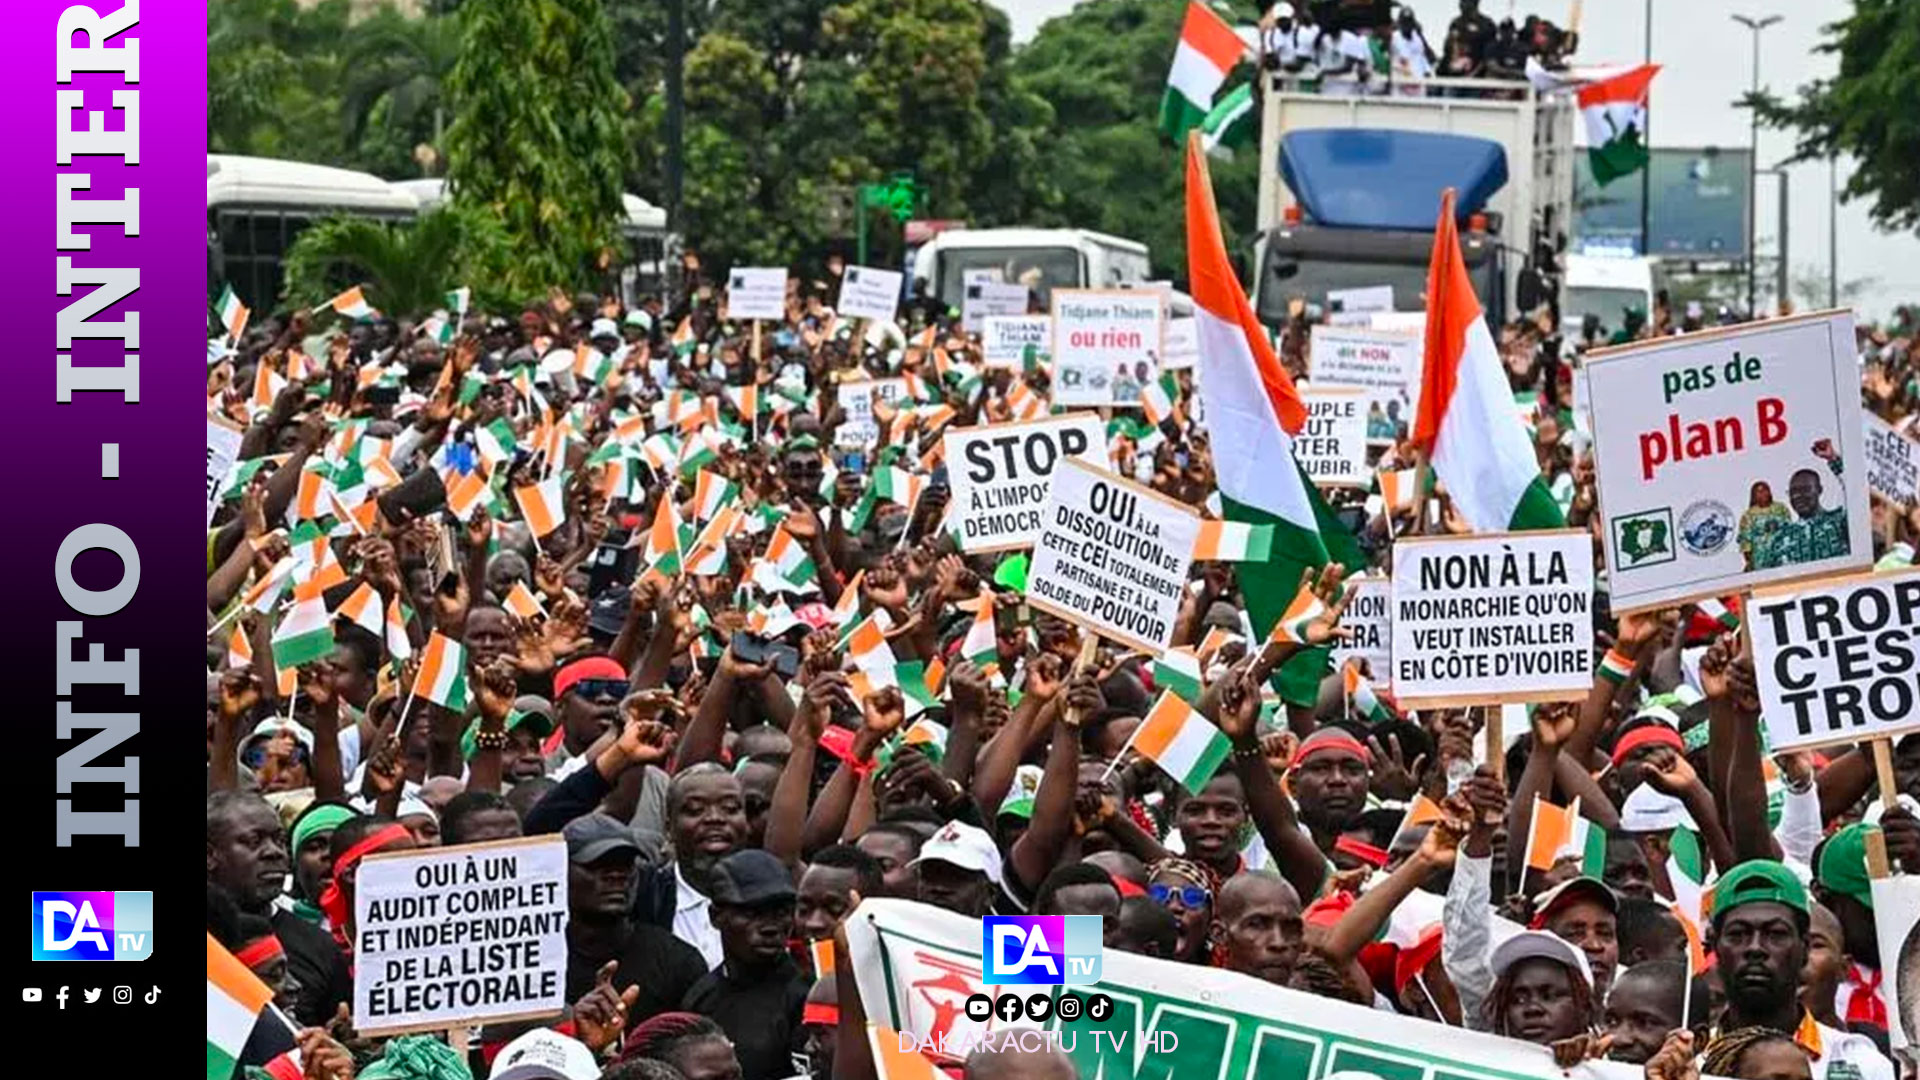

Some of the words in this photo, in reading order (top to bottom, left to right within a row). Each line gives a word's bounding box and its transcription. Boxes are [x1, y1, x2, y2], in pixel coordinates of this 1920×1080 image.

[1060, 304, 1108, 322] Tidjane
[1114, 305, 1154, 319] Thiam
[1070, 332, 1095, 349] ou
[1102, 328, 1142, 348] rien
[1663, 363, 1717, 404] pas
[1724, 351, 1762, 384] de
[965, 428, 1088, 484] STOP
[1638, 413, 1743, 481] plan
[1756, 397, 1789, 446] B
[971, 485, 984, 511] À
[1089, 481, 1137, 527] OUI
[1136, 513, 1147, 532] À
[1146, 517, 1160, 538] LA
[965, 509, 1045, 539] DÉMOCR
[1056, 505, 1164, 567] DISSOLUTION
[1164, 553, 1181, 574] DE
[1042, 531, 1081, 558] CETTE
[1080, 541, 1109, 570] CEI
[1109, 557, 1182, 600] TOTALEMENT
[1055, 559, 1119, 599] PARTISANE
[1119, 585, 1134, 604] ET
[1143, 595, 1158, 615] LA
[1420, 554, 1490, 591] NON
[1499, 544, 1520, 588] À
[1528, 551, 1568, 586] LA
[1033, 577, 1071, 605] SOLDE
[1073, 594, 1090, 612] DU
[1091, 595, 1166, 643] POUVOIR
[1400, 596, 1520, 621] MONARCHIE
[1526, 592, 1587, 619] QU'ON
[1759, 580, 1920, 646] TROP
[1413, 628, 1464, 651] VEUT
[1469, 623, 1574, 648] INSTALLER
[1773, 626, 1920, 690] C'ES
[1400, 660, 1425, 681] EN
[1431, 650, 1489, 680] CÔTE
[1495, 649, 1588, 677] D'IVOIRE
[1780, 672, 1920, 735] TRO
[415, 863, 457, 888] OUI
[464, 856, 479, 884] À
[484, 857, 517, 881] UN
[367, 894, 440, 923] AUDIT
[447, 882, 558, 915] COMPLET
[361, 930, 389, 953] ET
[397, 911, 566, 950] INDÉPENDANT
[386, 959, 417, 982] DE
[424, 955, 453, 978] LA
[461, 940, 540, 975] LISTE
[369, 971, 556, 1016] ÉLECTORALE
